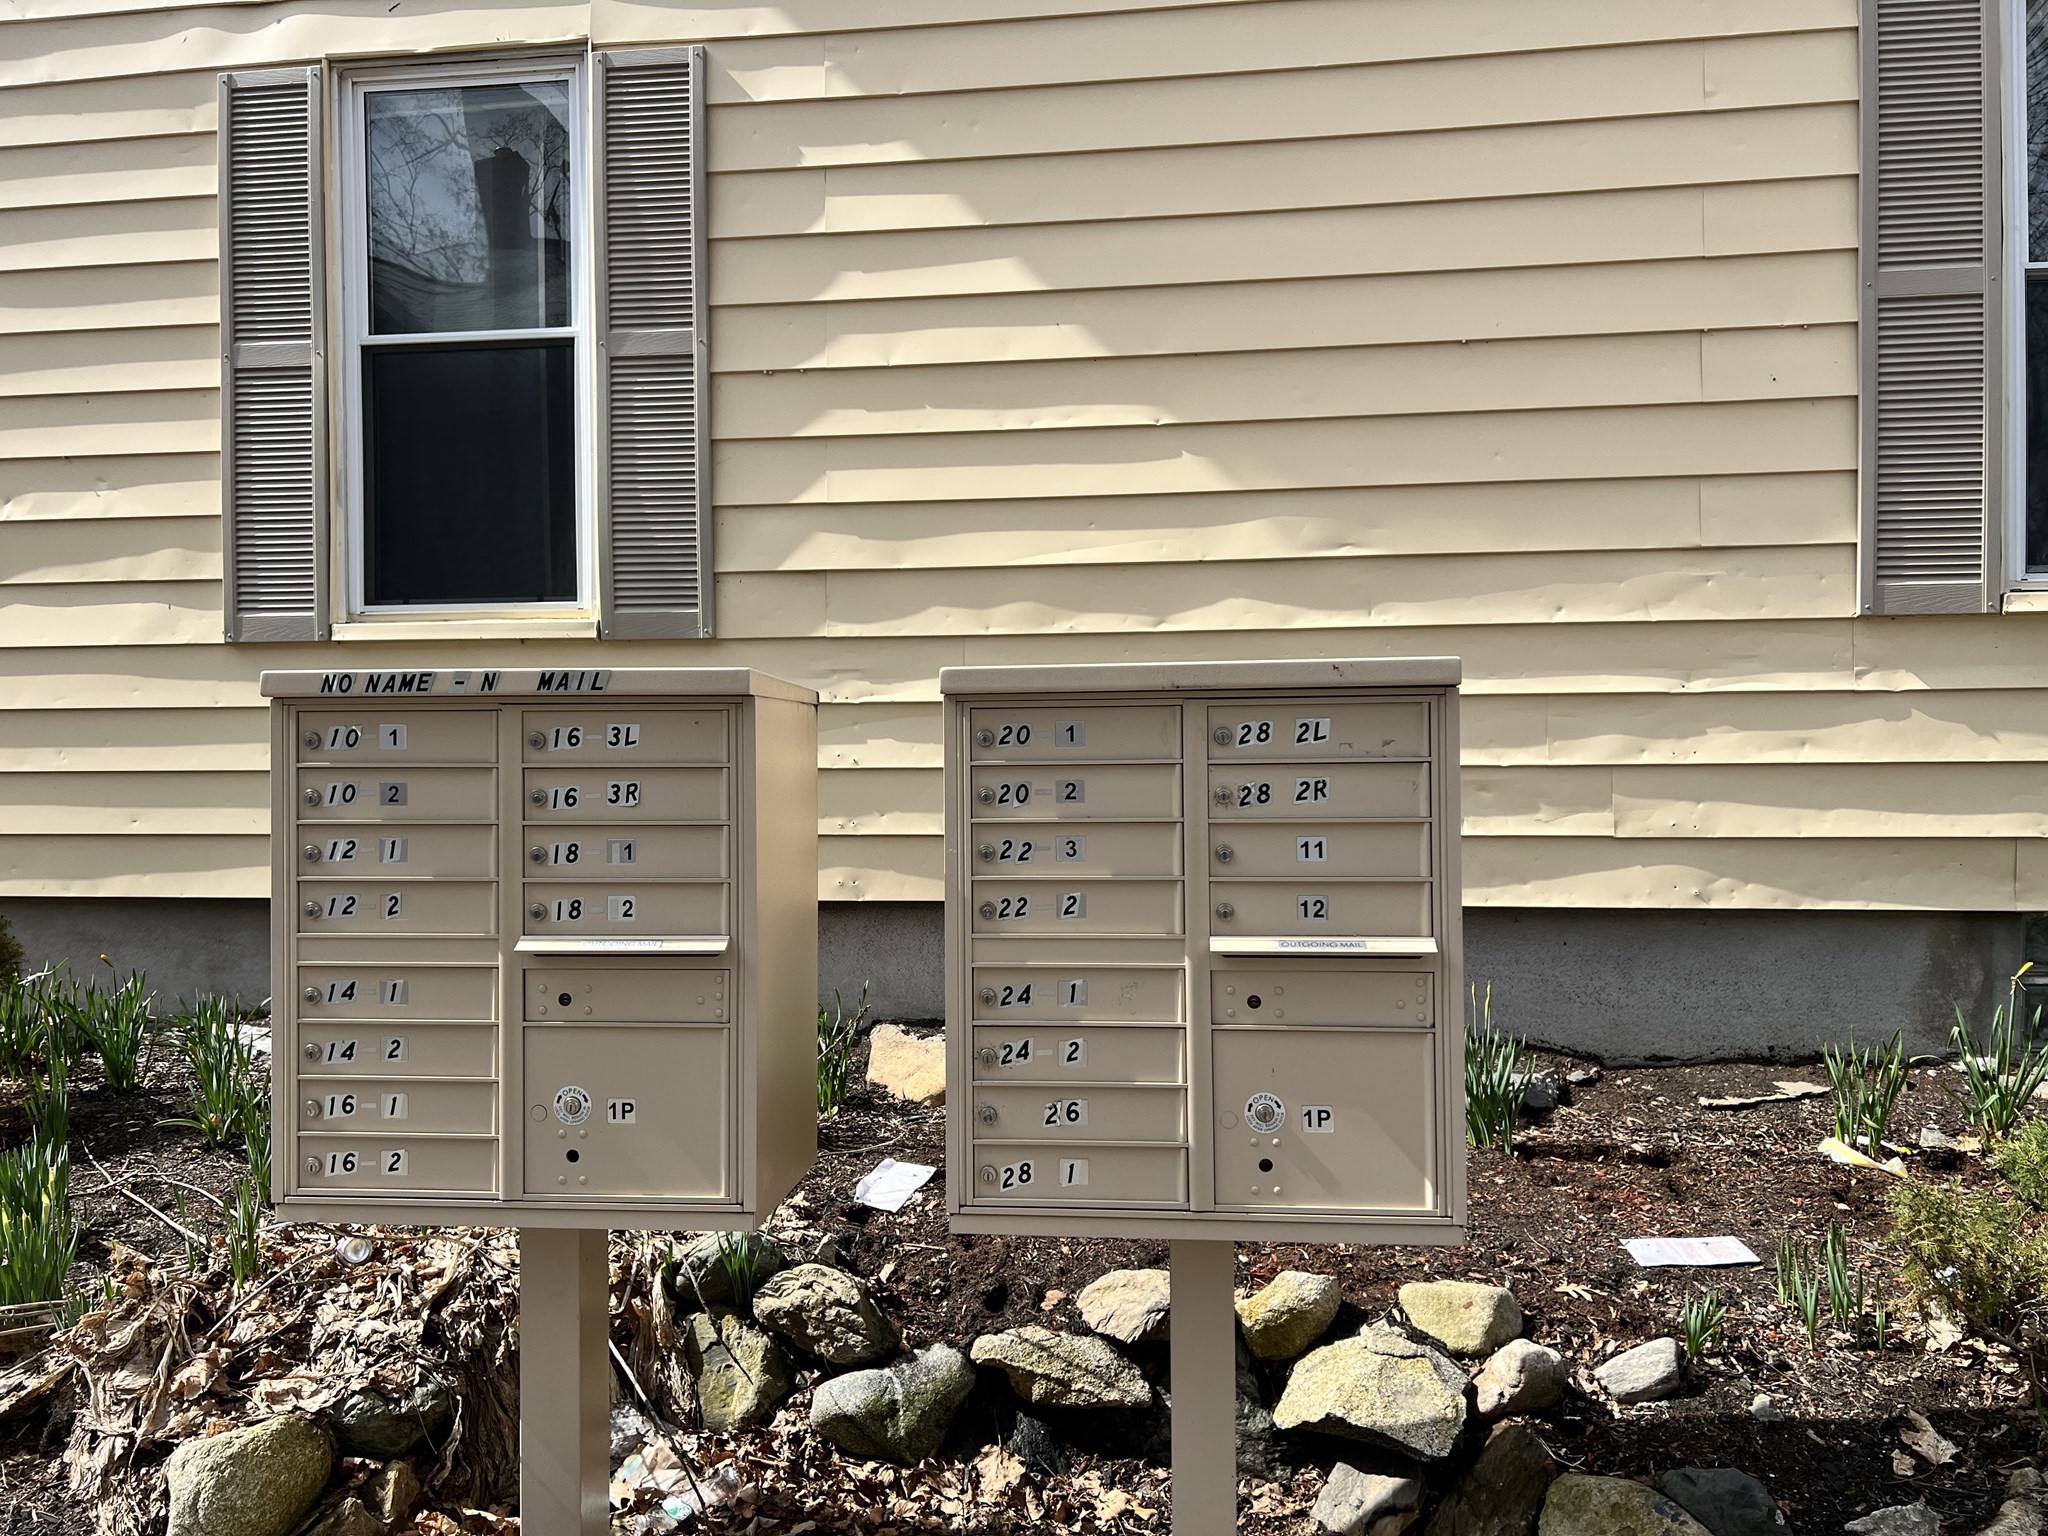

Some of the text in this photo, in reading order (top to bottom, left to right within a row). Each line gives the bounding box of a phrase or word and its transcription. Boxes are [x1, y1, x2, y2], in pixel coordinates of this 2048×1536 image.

[321, 674, 352, 693] NO
[365, 673, 432, 692] NAME
[480, 672, 496, 691] N
[537, 672, 603, 691] MAIL
[331, 729, 397, 748] 10 1
[554, 727, 636, 748] 16 3L
[999, 725, 1074, 745] 20 1
[1239, 721, 1326, 745] 28 2L
[329, 784, 400, 803] 10 2
[553, 783, 639, 809] 16 3R
[998, 783, 1076, 804] 20 2
[1238, 780, 1327, 807] 28 2R
[329, 840, 396, 860] 12 1
[554, 843, 631, 864] 18 1
[1000, 840, 1077, 861] 22 3
[1301, 841, 1322, 858] 11
[328, 896, 398, 916] 12 2
[557, 900, 633, 920] 18 2
[998, 896, 1077, 918] 22 2
[1300, 900, 1324, 918] 12
[328, 981, 397, 1002] 14 1
[1000, 983, 1076, 1006] 24 1
[328, 1040, 400, 1061] 14 2
[1001, 1040, 1079, 1065] 24 2
[562, 1088, 582, 1096] OPEN
[1253, 1095, 1274, 1103] OPEN
[330, 1095, 397, 1116] 16 1
[609, 1103, 634, 1119] 1P
[1045, 1102, 1079, 1125] 26
[1304, 1110, 1330, 1127] 1P
[331, 1153, 401, 1173] 16 2
[1003, 1163, 1074, 1189] 28 1
